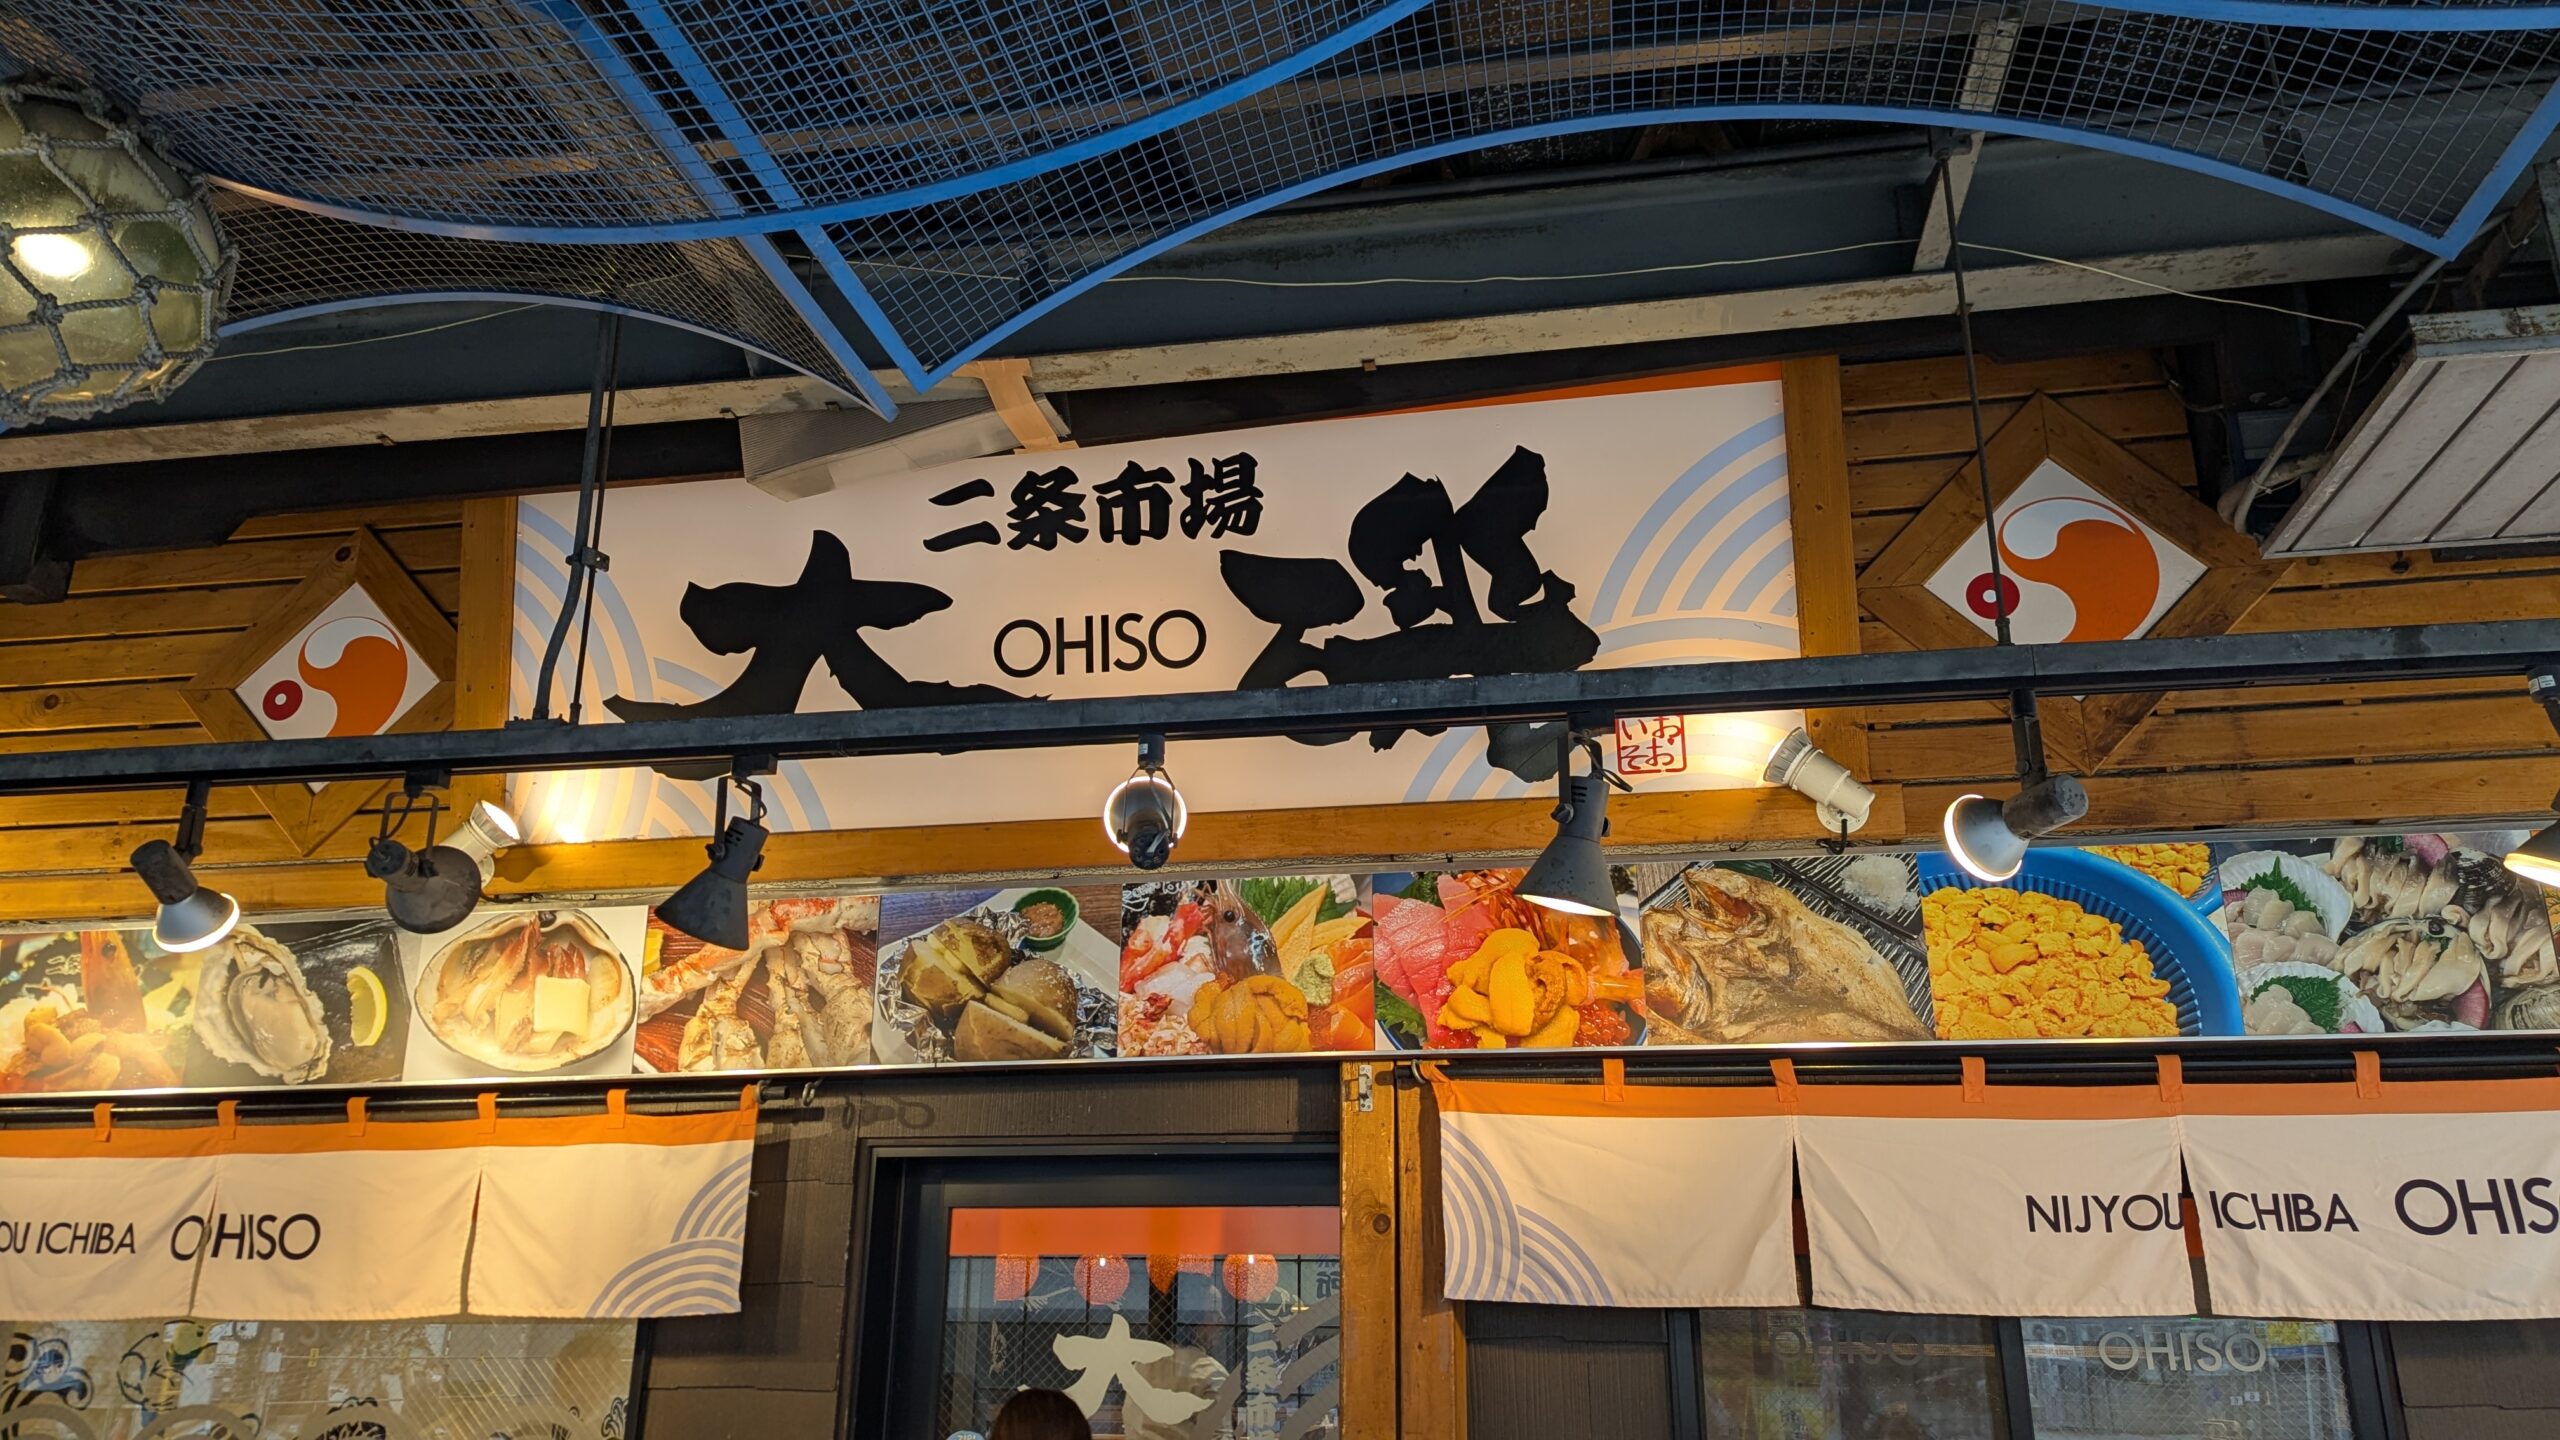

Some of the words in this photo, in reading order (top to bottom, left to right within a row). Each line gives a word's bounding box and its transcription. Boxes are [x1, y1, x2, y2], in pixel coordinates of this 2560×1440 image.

[922, 452, 1264, 552] 二条市場
[603, 530, 1051, 781] 大
[994, 609, 1207, 679] OHISO
[36, 1221, 136, 1254] ICHIBA
[170, 1213, 321, 1261] OHISO
[2027, 1193, 2184, 1233] NIJYOU
[2209, 1190, 2359, 1232] ICHIBA
[2395, 1177, 2560, 1236] OHIS
[2098, 1331, 2266, 1372] OHISO
